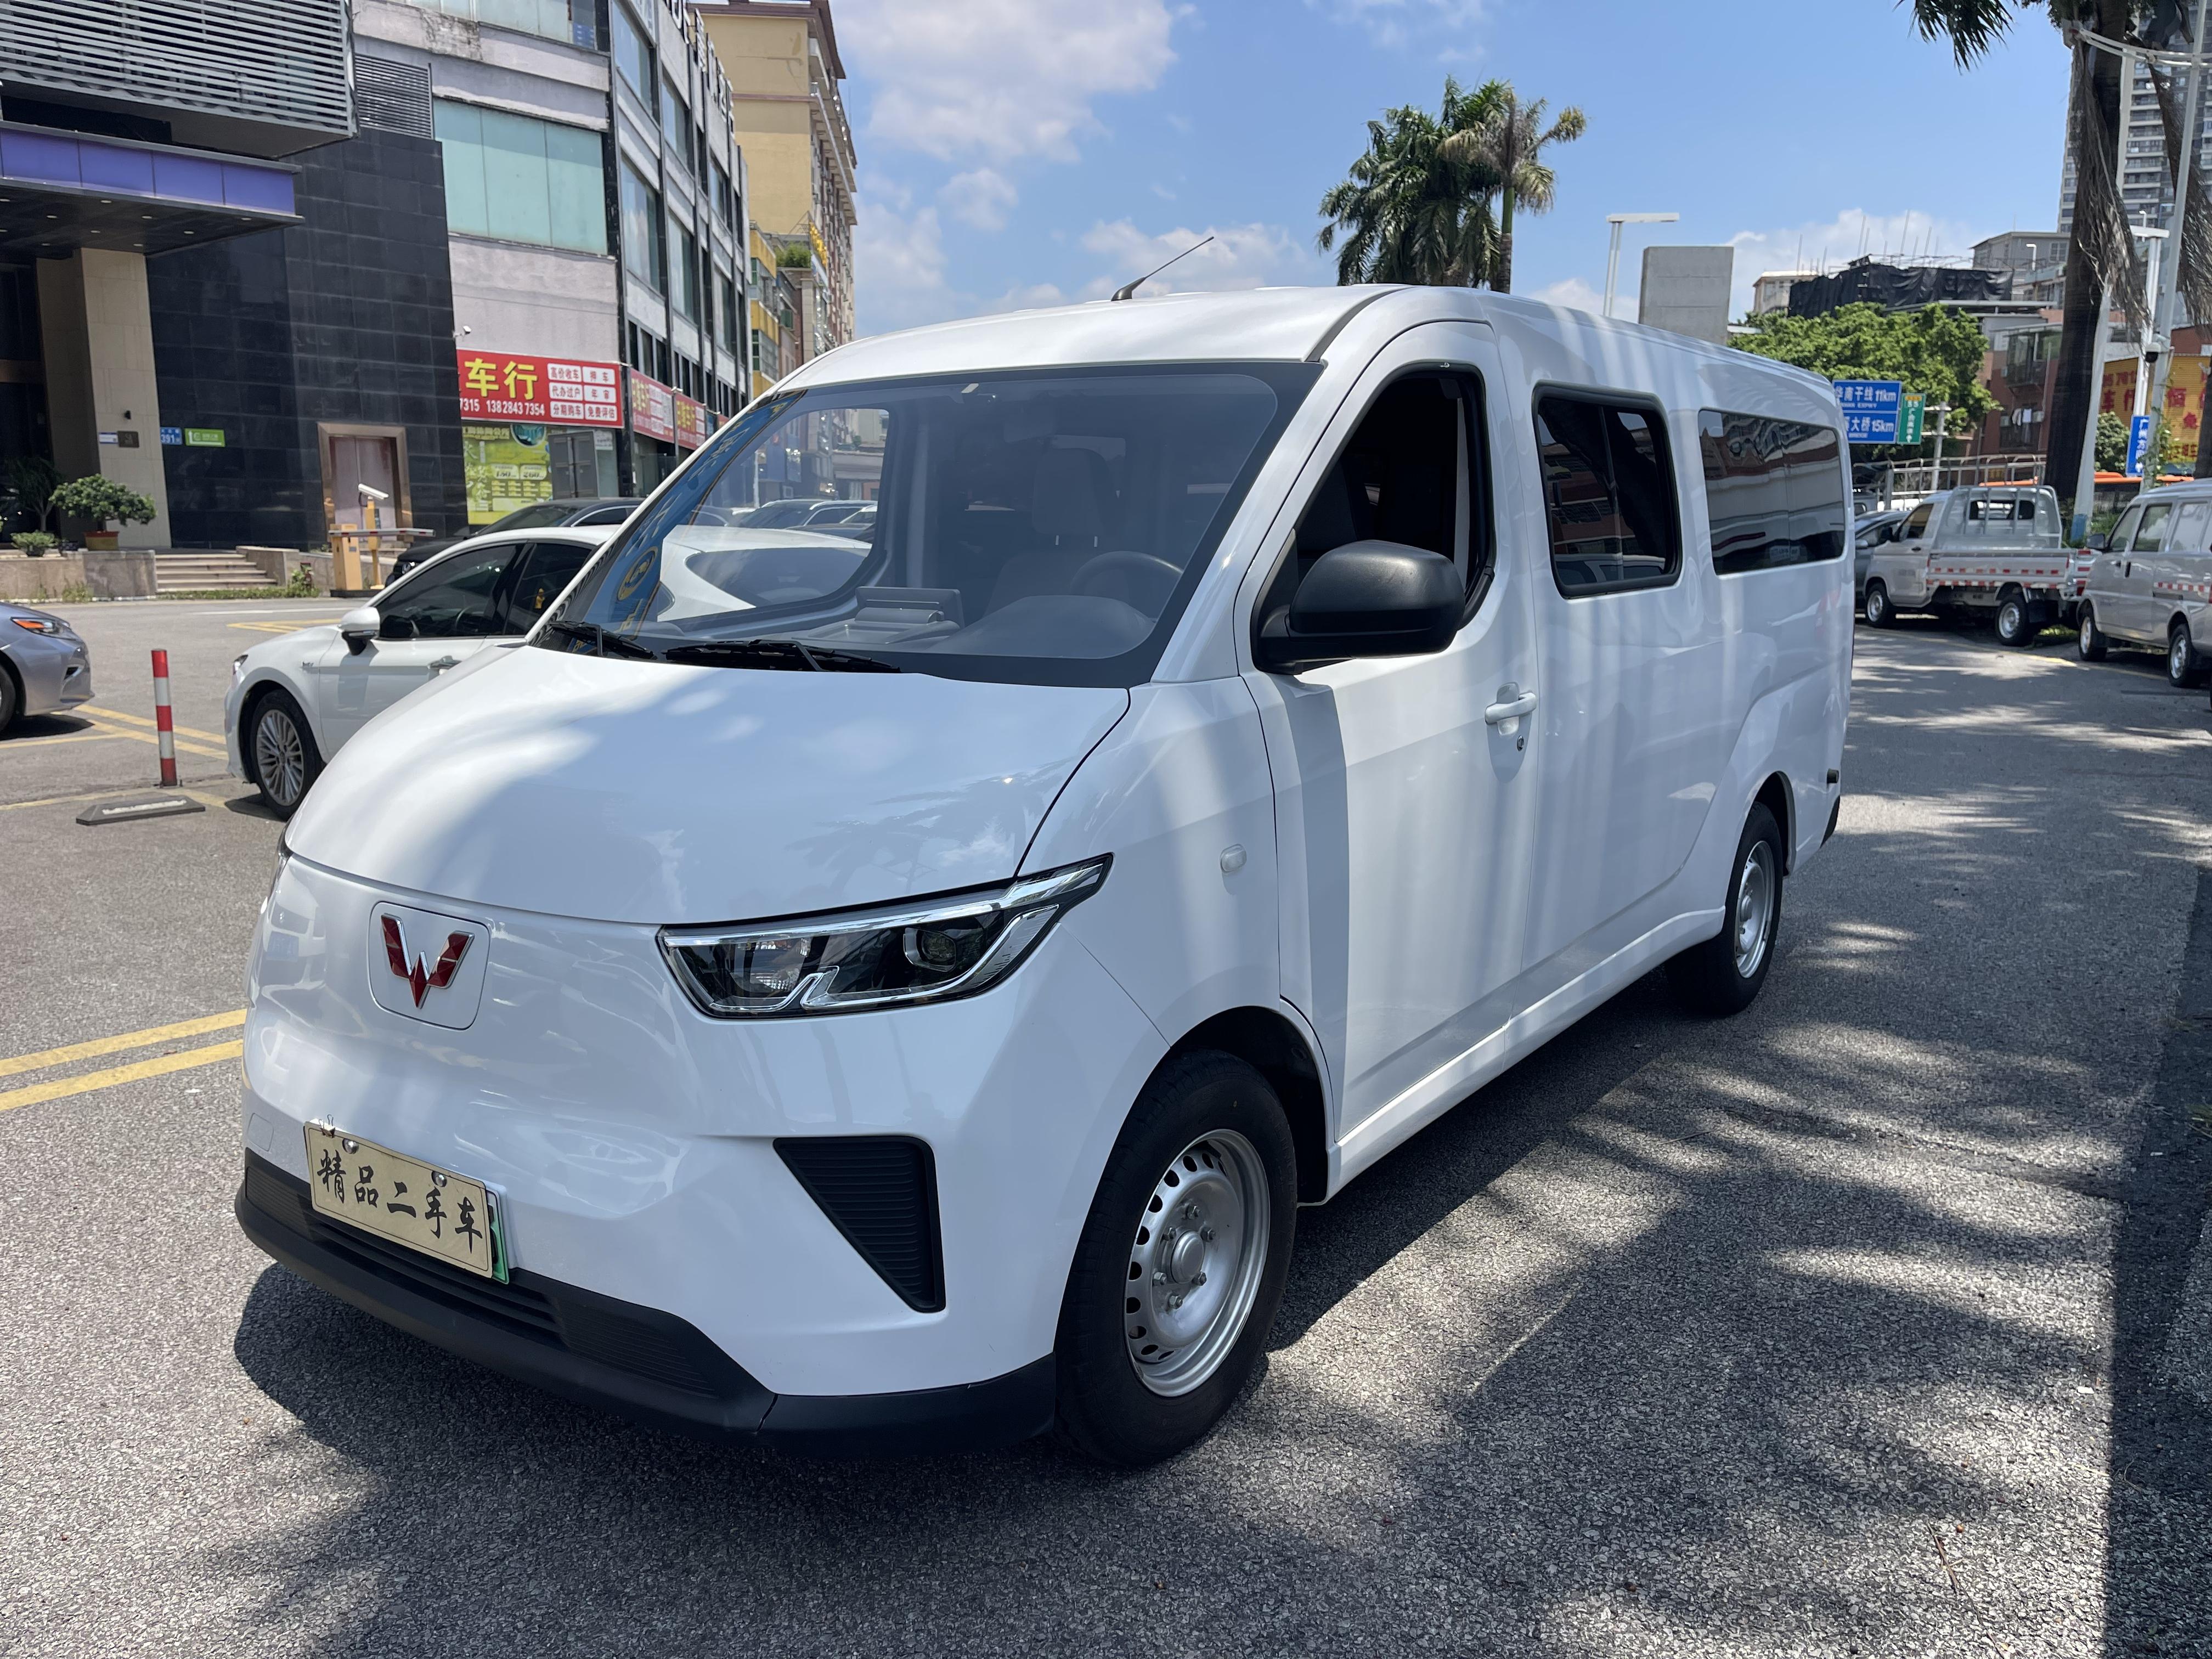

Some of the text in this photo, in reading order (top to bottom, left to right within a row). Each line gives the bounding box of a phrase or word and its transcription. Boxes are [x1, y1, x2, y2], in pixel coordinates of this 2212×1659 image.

[465, 358, 538, 400] 车行
[550, 367, 579, 380] 高价收车
[552, 386, 580, 398] 代办过户
[553, 404, 582, 416] 分期购车
[588, 406, 615, 418] 免费评估
[317, 1149, 483, 1254] 精品二手车
